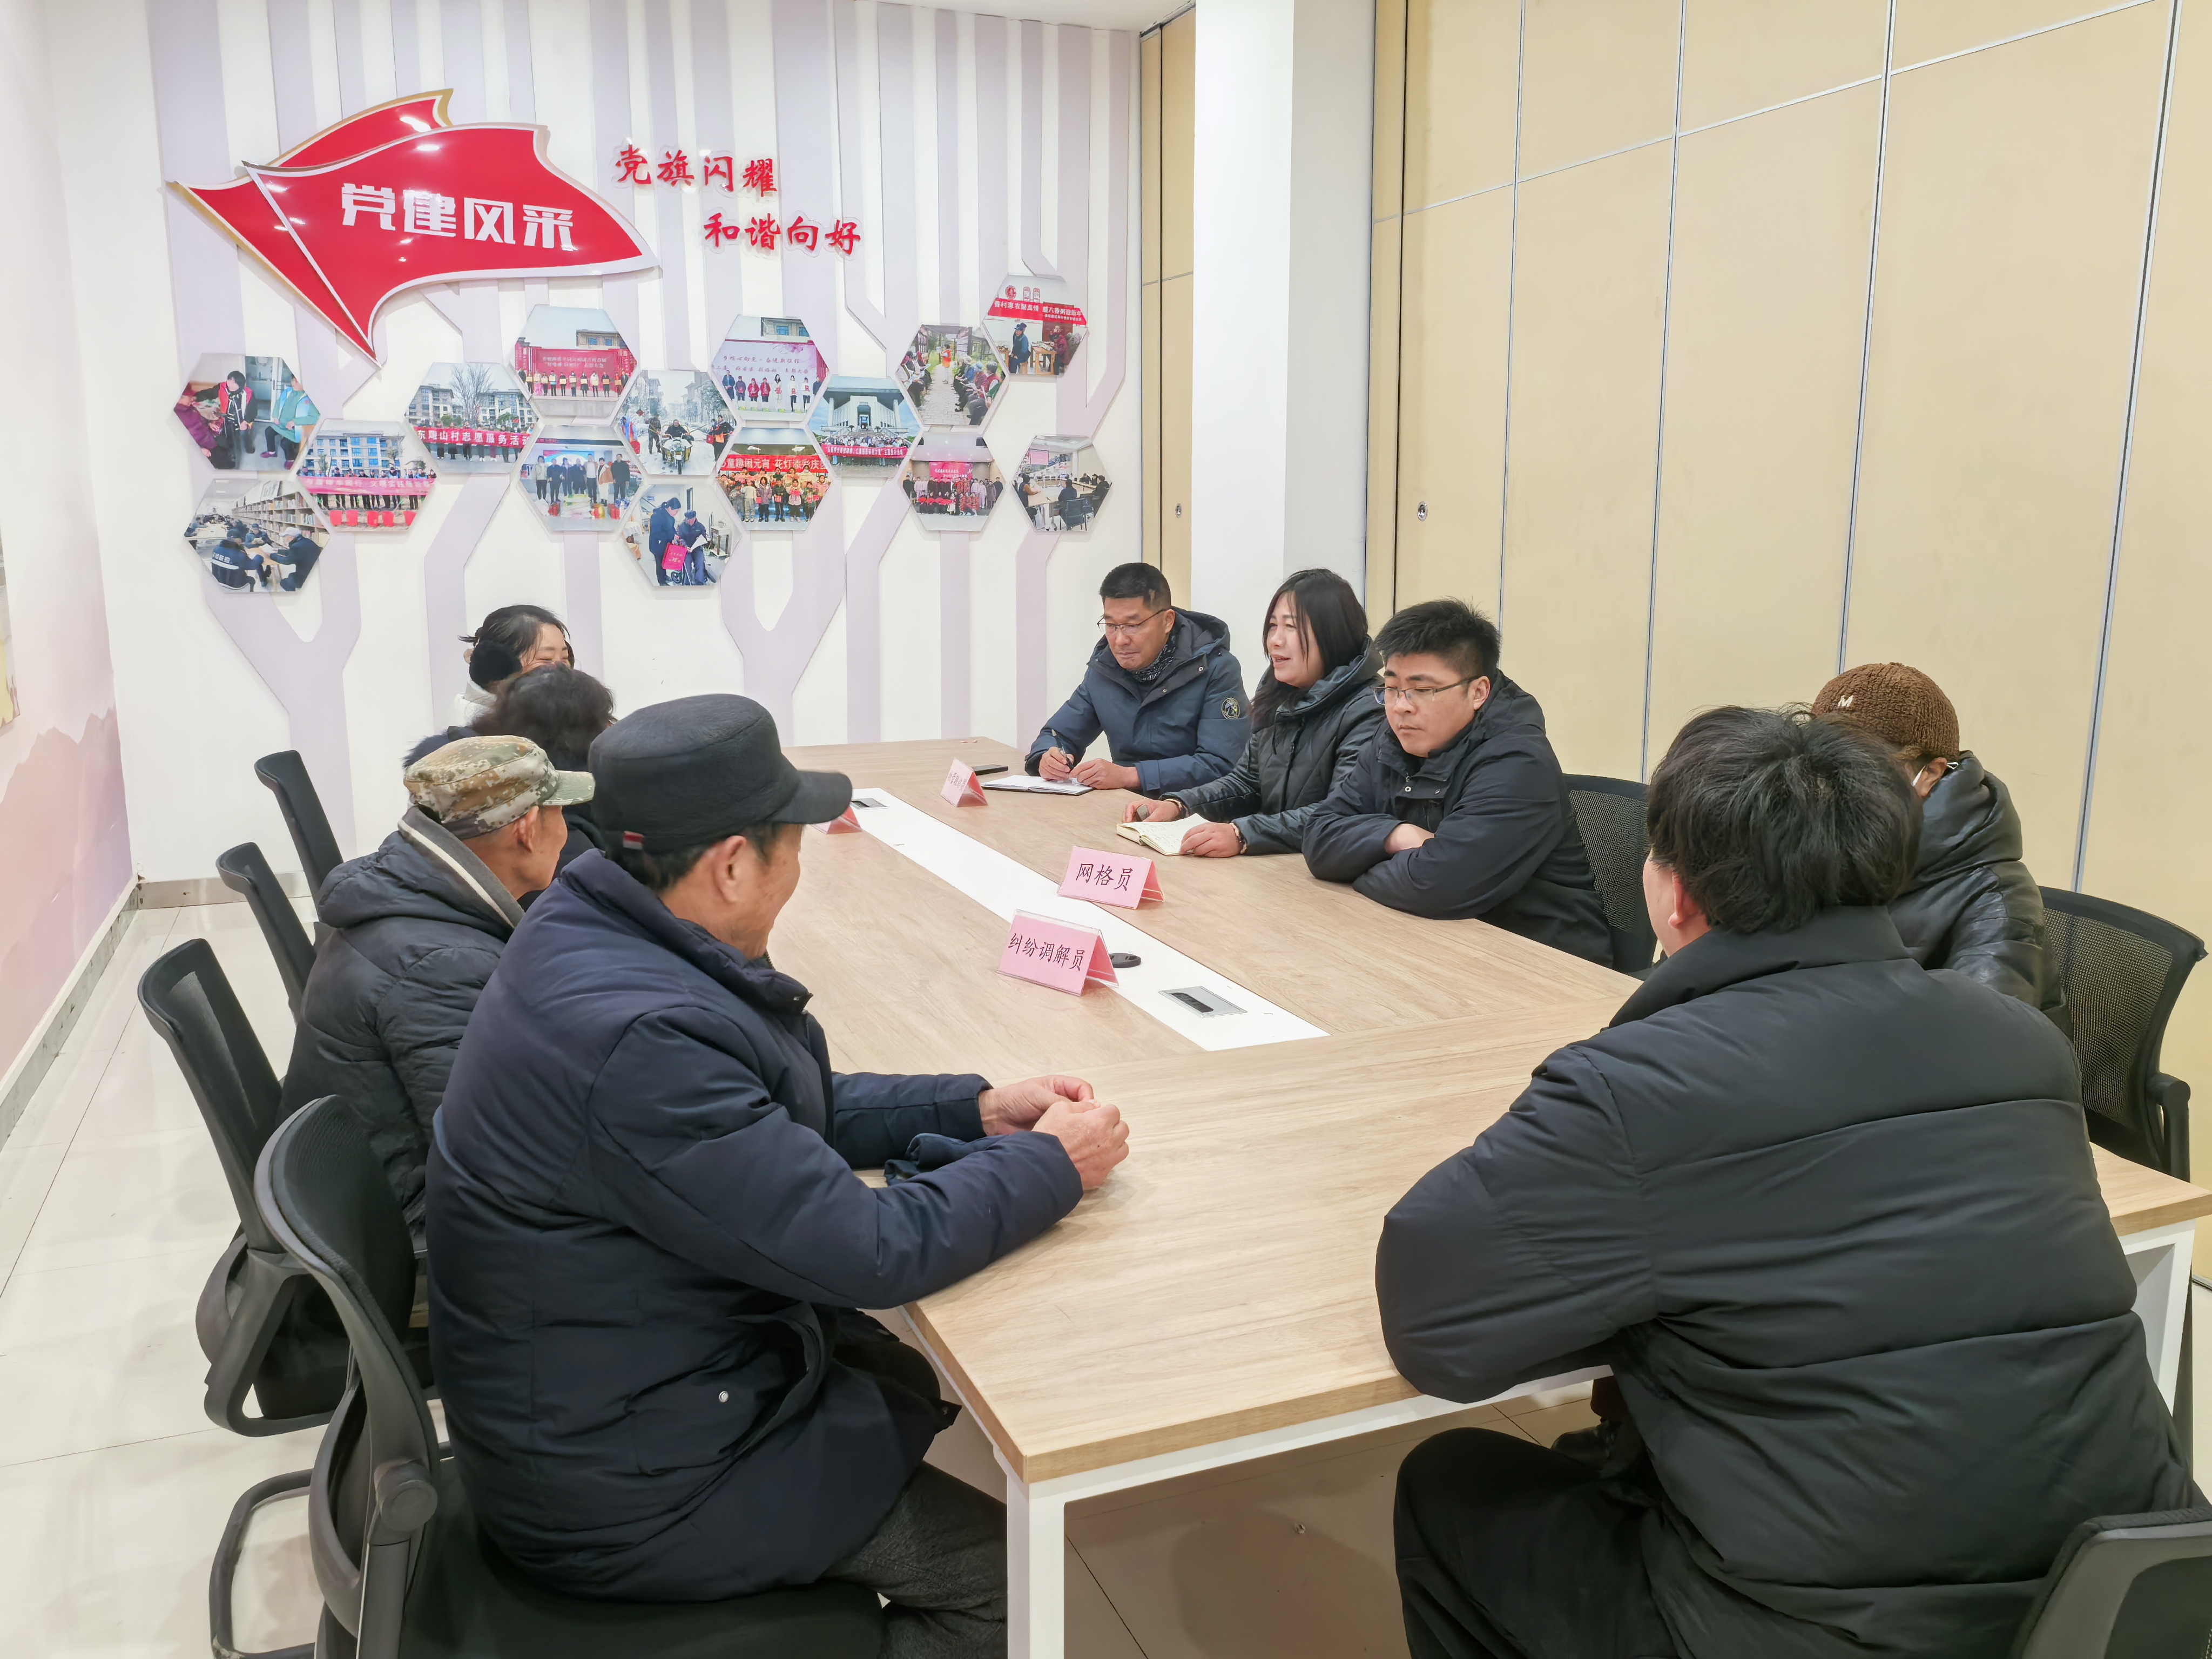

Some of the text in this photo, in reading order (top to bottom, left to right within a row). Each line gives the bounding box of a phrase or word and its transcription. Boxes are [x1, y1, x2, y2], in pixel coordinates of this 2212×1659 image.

[615, 144, 777, 197] 党旗闪耀
[341, 183, 577, 251] 党建风采
[704, 213, 861, 254] 和谐向好
[1838, 695, 1854, 707] M
[1076, 863, 1134, 892] 网格员
[1008, 933, 1085, 972] 纠纷调解员
